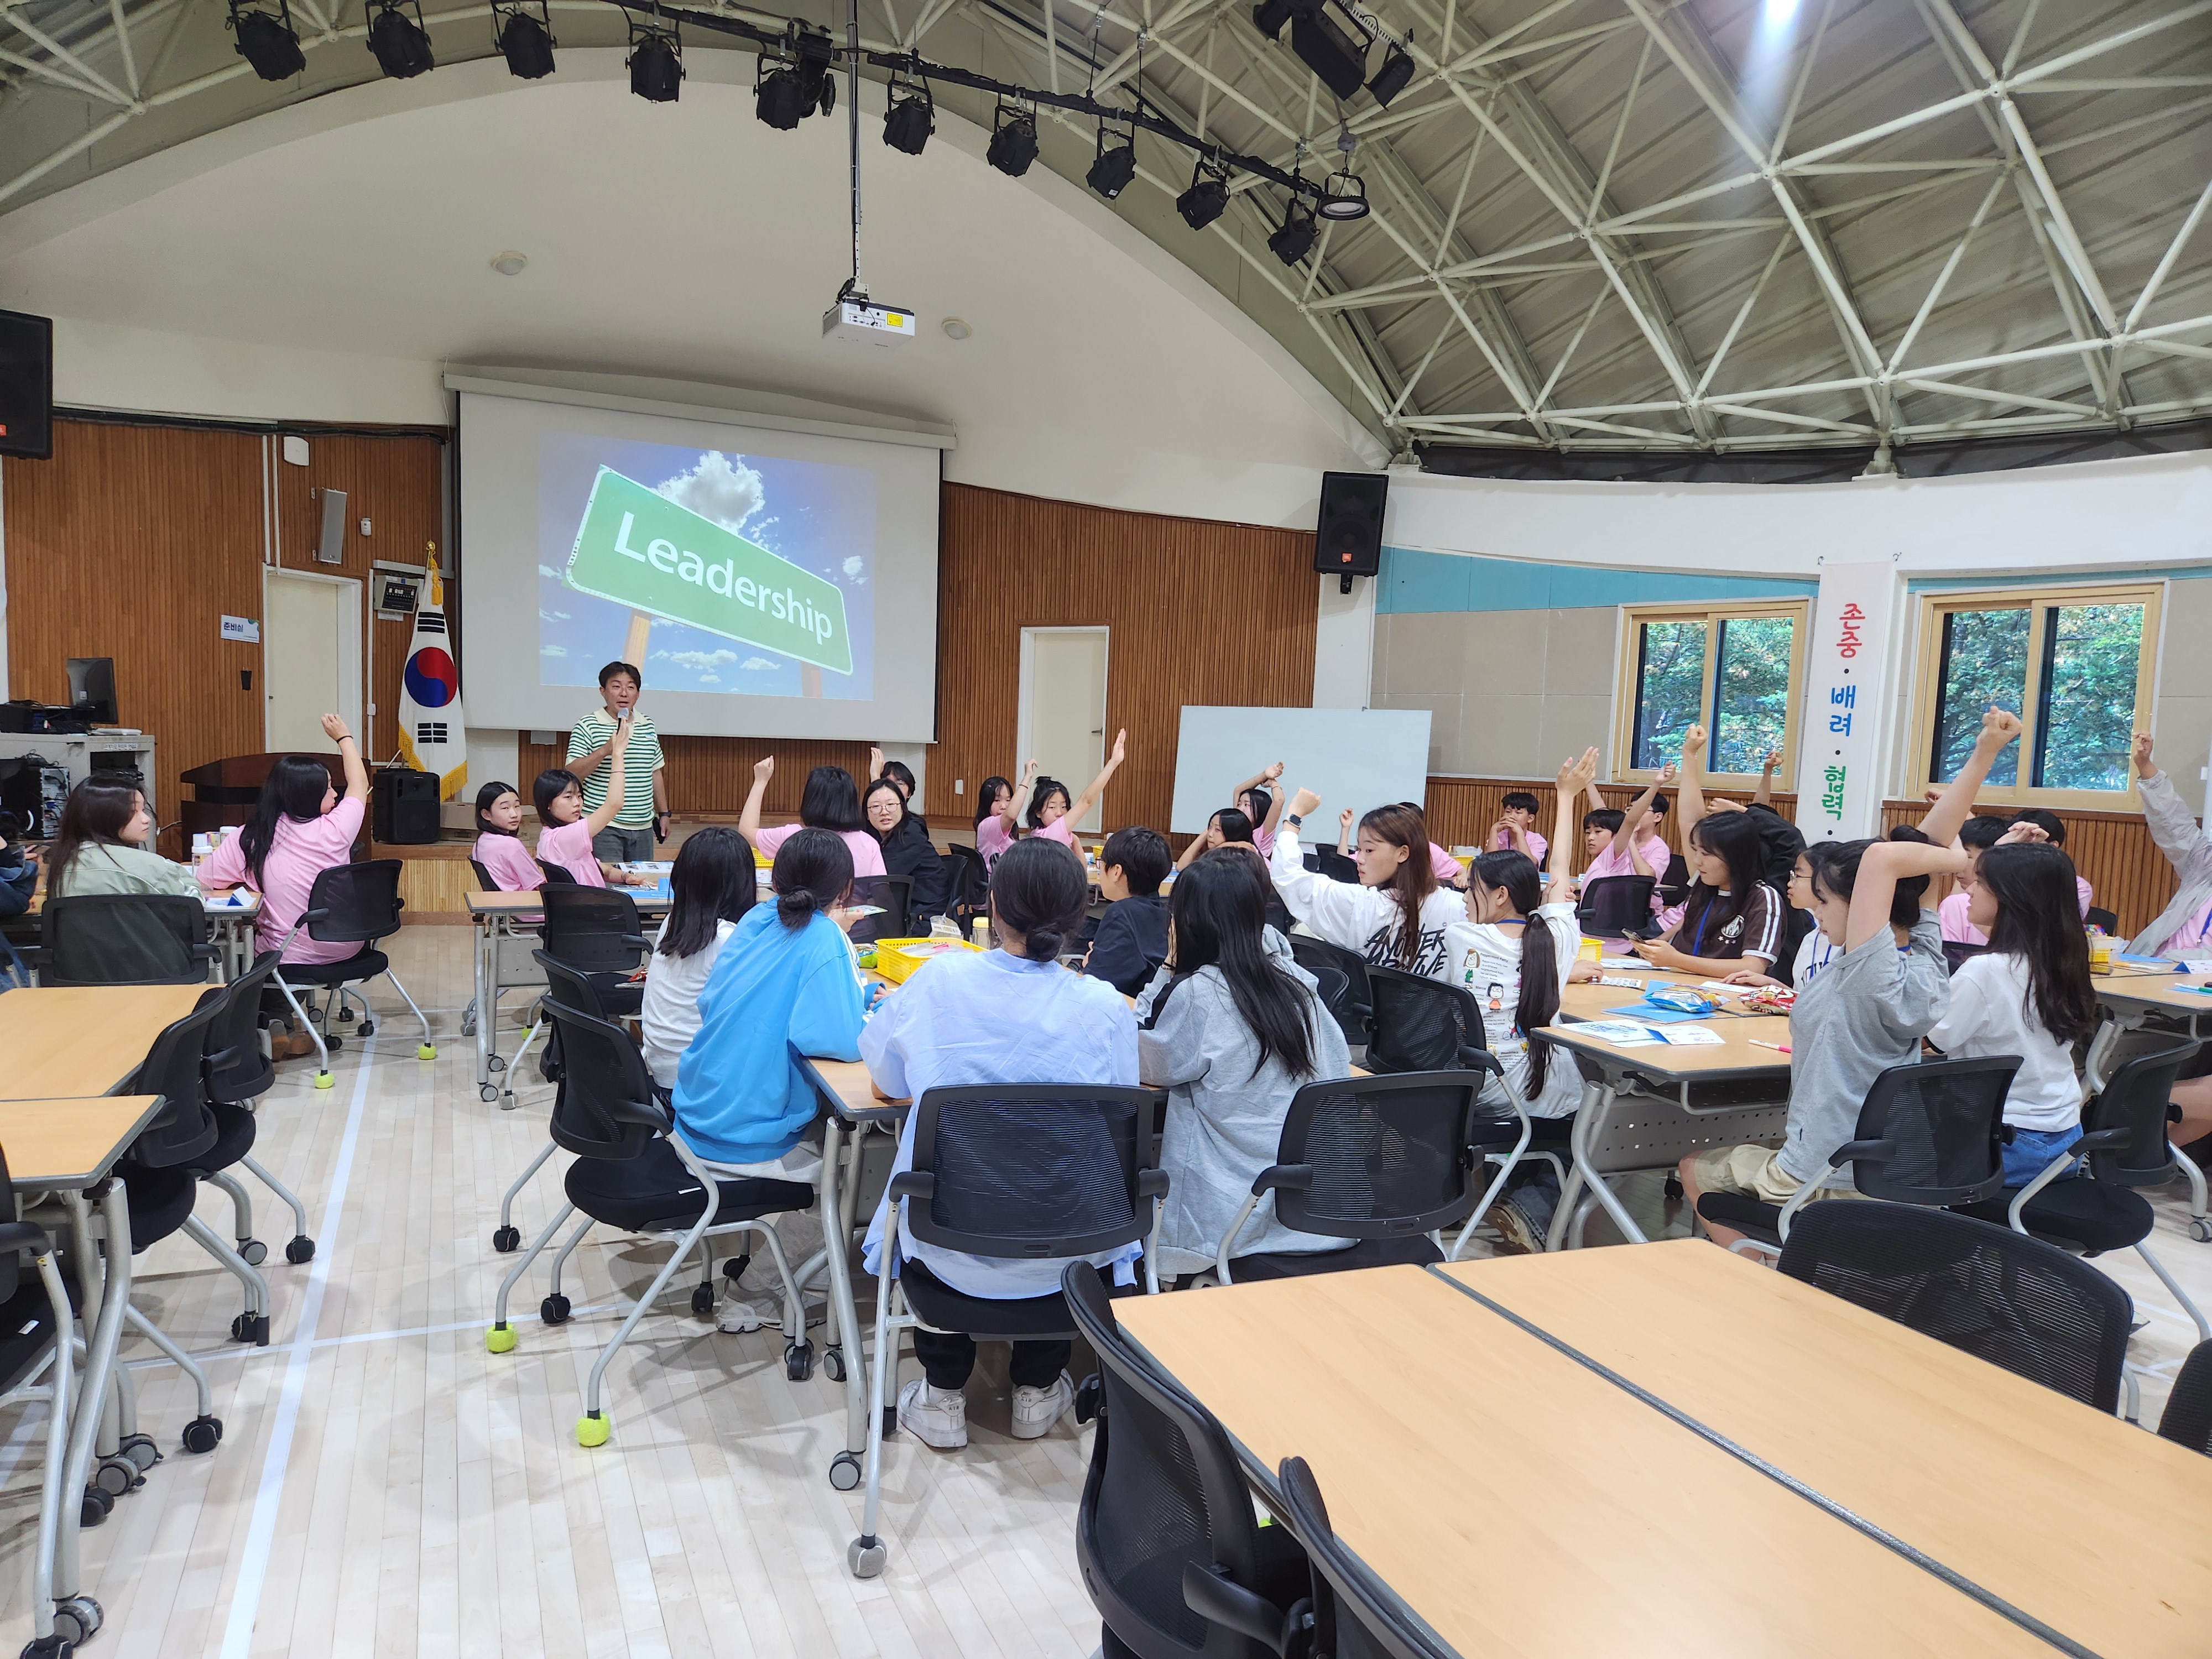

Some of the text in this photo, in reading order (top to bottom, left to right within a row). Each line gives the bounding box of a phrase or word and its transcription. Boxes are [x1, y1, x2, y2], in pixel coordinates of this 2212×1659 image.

[224, 622, 243, 633] 준비실
[614, 510, 833, 645] Leadership
[1822, 603, 1866, 821] 존중 배려 협력
